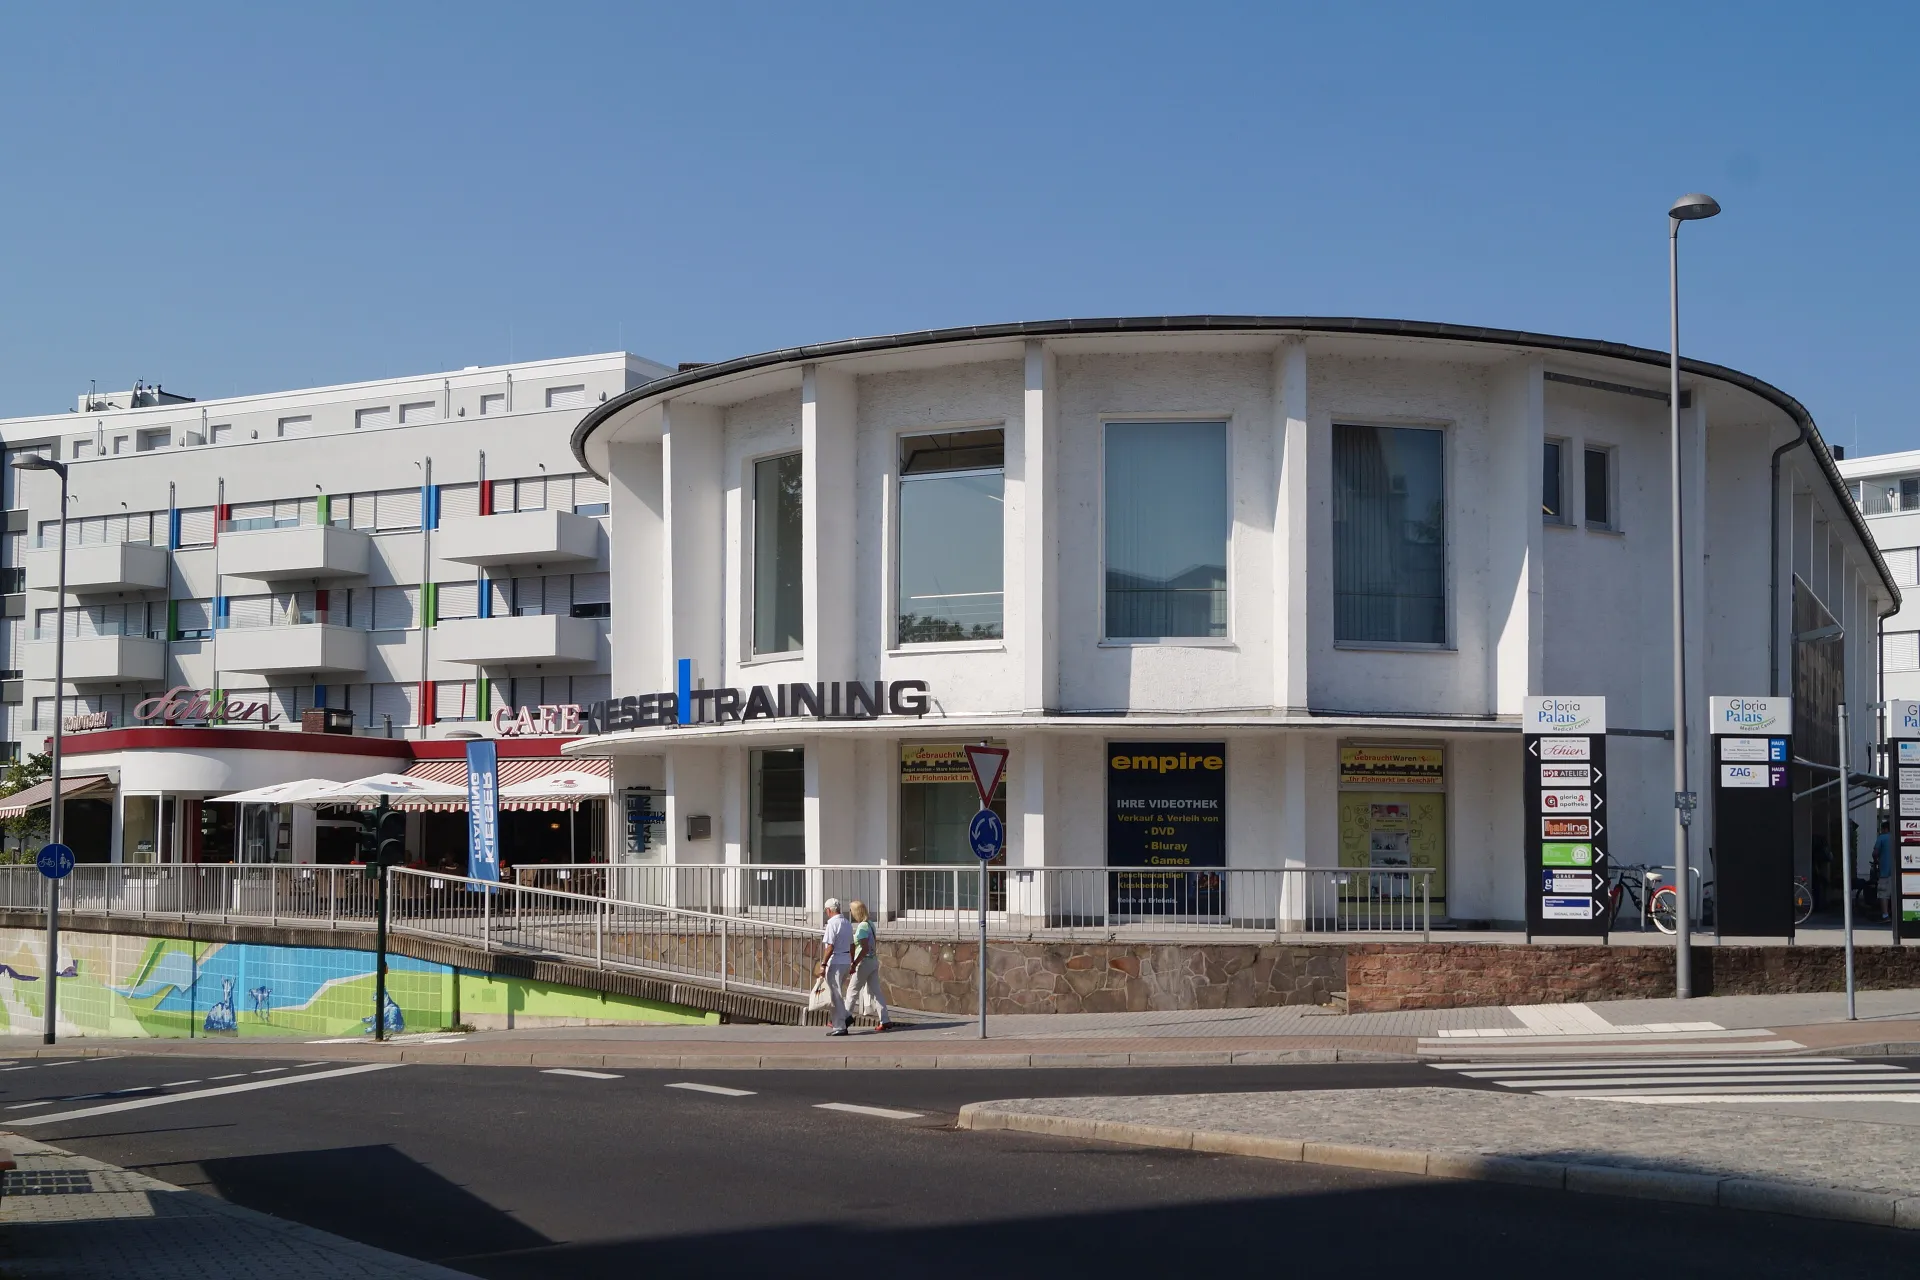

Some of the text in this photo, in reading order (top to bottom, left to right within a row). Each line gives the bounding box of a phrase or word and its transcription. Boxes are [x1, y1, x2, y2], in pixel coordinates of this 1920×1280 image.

[133, 685, 281, 722] Schien
[588, 680, 930, 734] KIESER TRAINING
[1542, 700, 1580, 711] Gloria
[1730, 699, 1767, 711] Gloria
[493, 704, 583, 735] CAFE
[1538, 711, 1576, 722] Palais
[1726, 710, 1763, 722] Palais
[1771, 748, 1780, 760] E
[1111, 752, 1224, 774] empire
[1730, 767, 1751, 777] ZAG
[922, 774, 958, 782] Flohmarkt
[1771, 774, 1780, 786] F
[1117, 799, 1219, 809] IHRE VIDEOTHEK
[1117, 814, 1154, 822] Verkauf
[1157, 814, 1164, 822] &
[1167, 814, 1200, 822] Verleih
[1151, 827, 1175, 836] DVD
[1151, 841, 1188, 852] Bluray
[1151, 856, 1190, 865] Games
